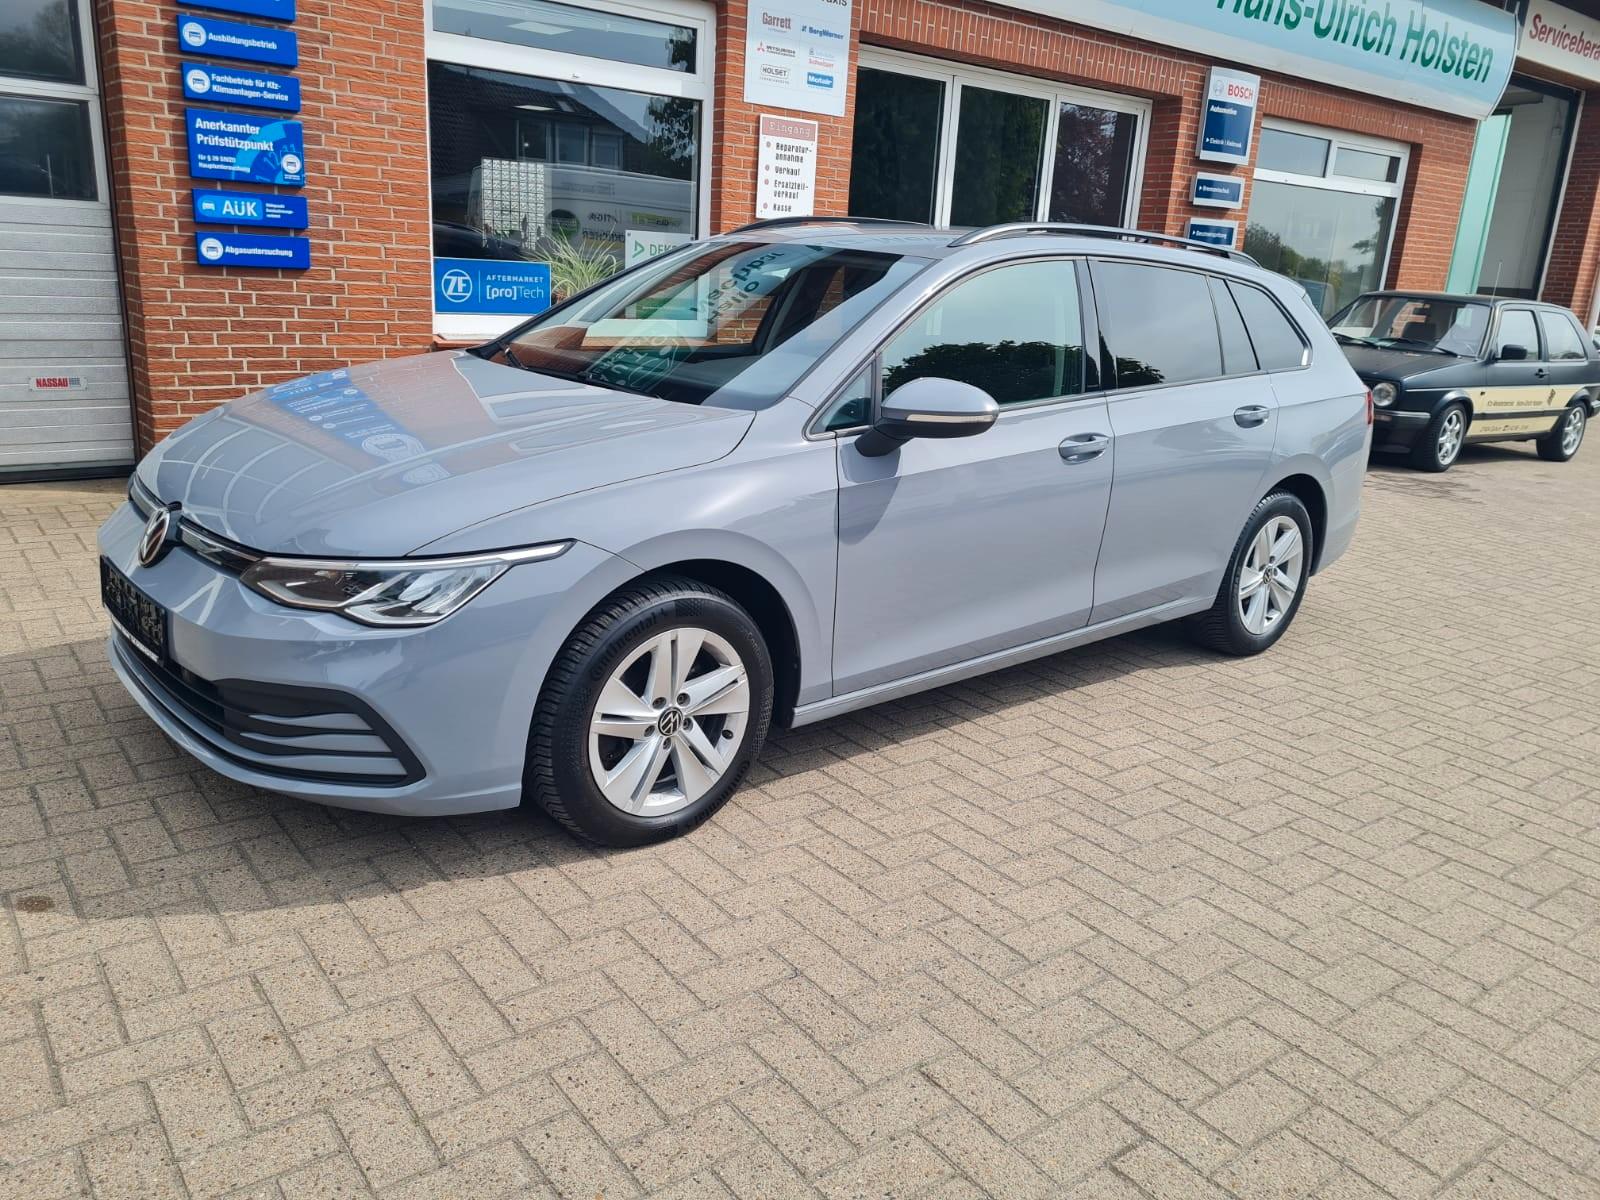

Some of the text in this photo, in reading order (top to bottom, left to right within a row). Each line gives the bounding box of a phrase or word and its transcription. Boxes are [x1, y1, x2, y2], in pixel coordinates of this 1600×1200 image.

[762, 11, 792, 29] Garrett
[208, 33, 277, 50] Ausbildungsbetrieb
[808, 27, 843, 39] BorgWarner
[1216, 0, 1494, 83] ans-Ulrich Holsten
[1529, 13, 1600, 61] Servicebera
[762, 67, 786, 76] HOLSET
[211, 73, 282, 91] Fachbetrieb für Kfz-
[211, 84, 289, 102] Klimaanlagen-Service
[1227, 83, 1254, 100] BOSCH
[196, 118, 260, 134] Anerkannter
[768, 121, 811, 137] Eingang
[196, 133, 274, 152] Prüfstützpunkt
[222, 199, 258, 218] AÜK
[224, 245, 293, 258] Abgasuntersuchung
[486, 273, 545, 284] AFTERMARKET
[486, 284, 545, 301] [pro]Tech
[35, 377, 69, 388] NASSAU
